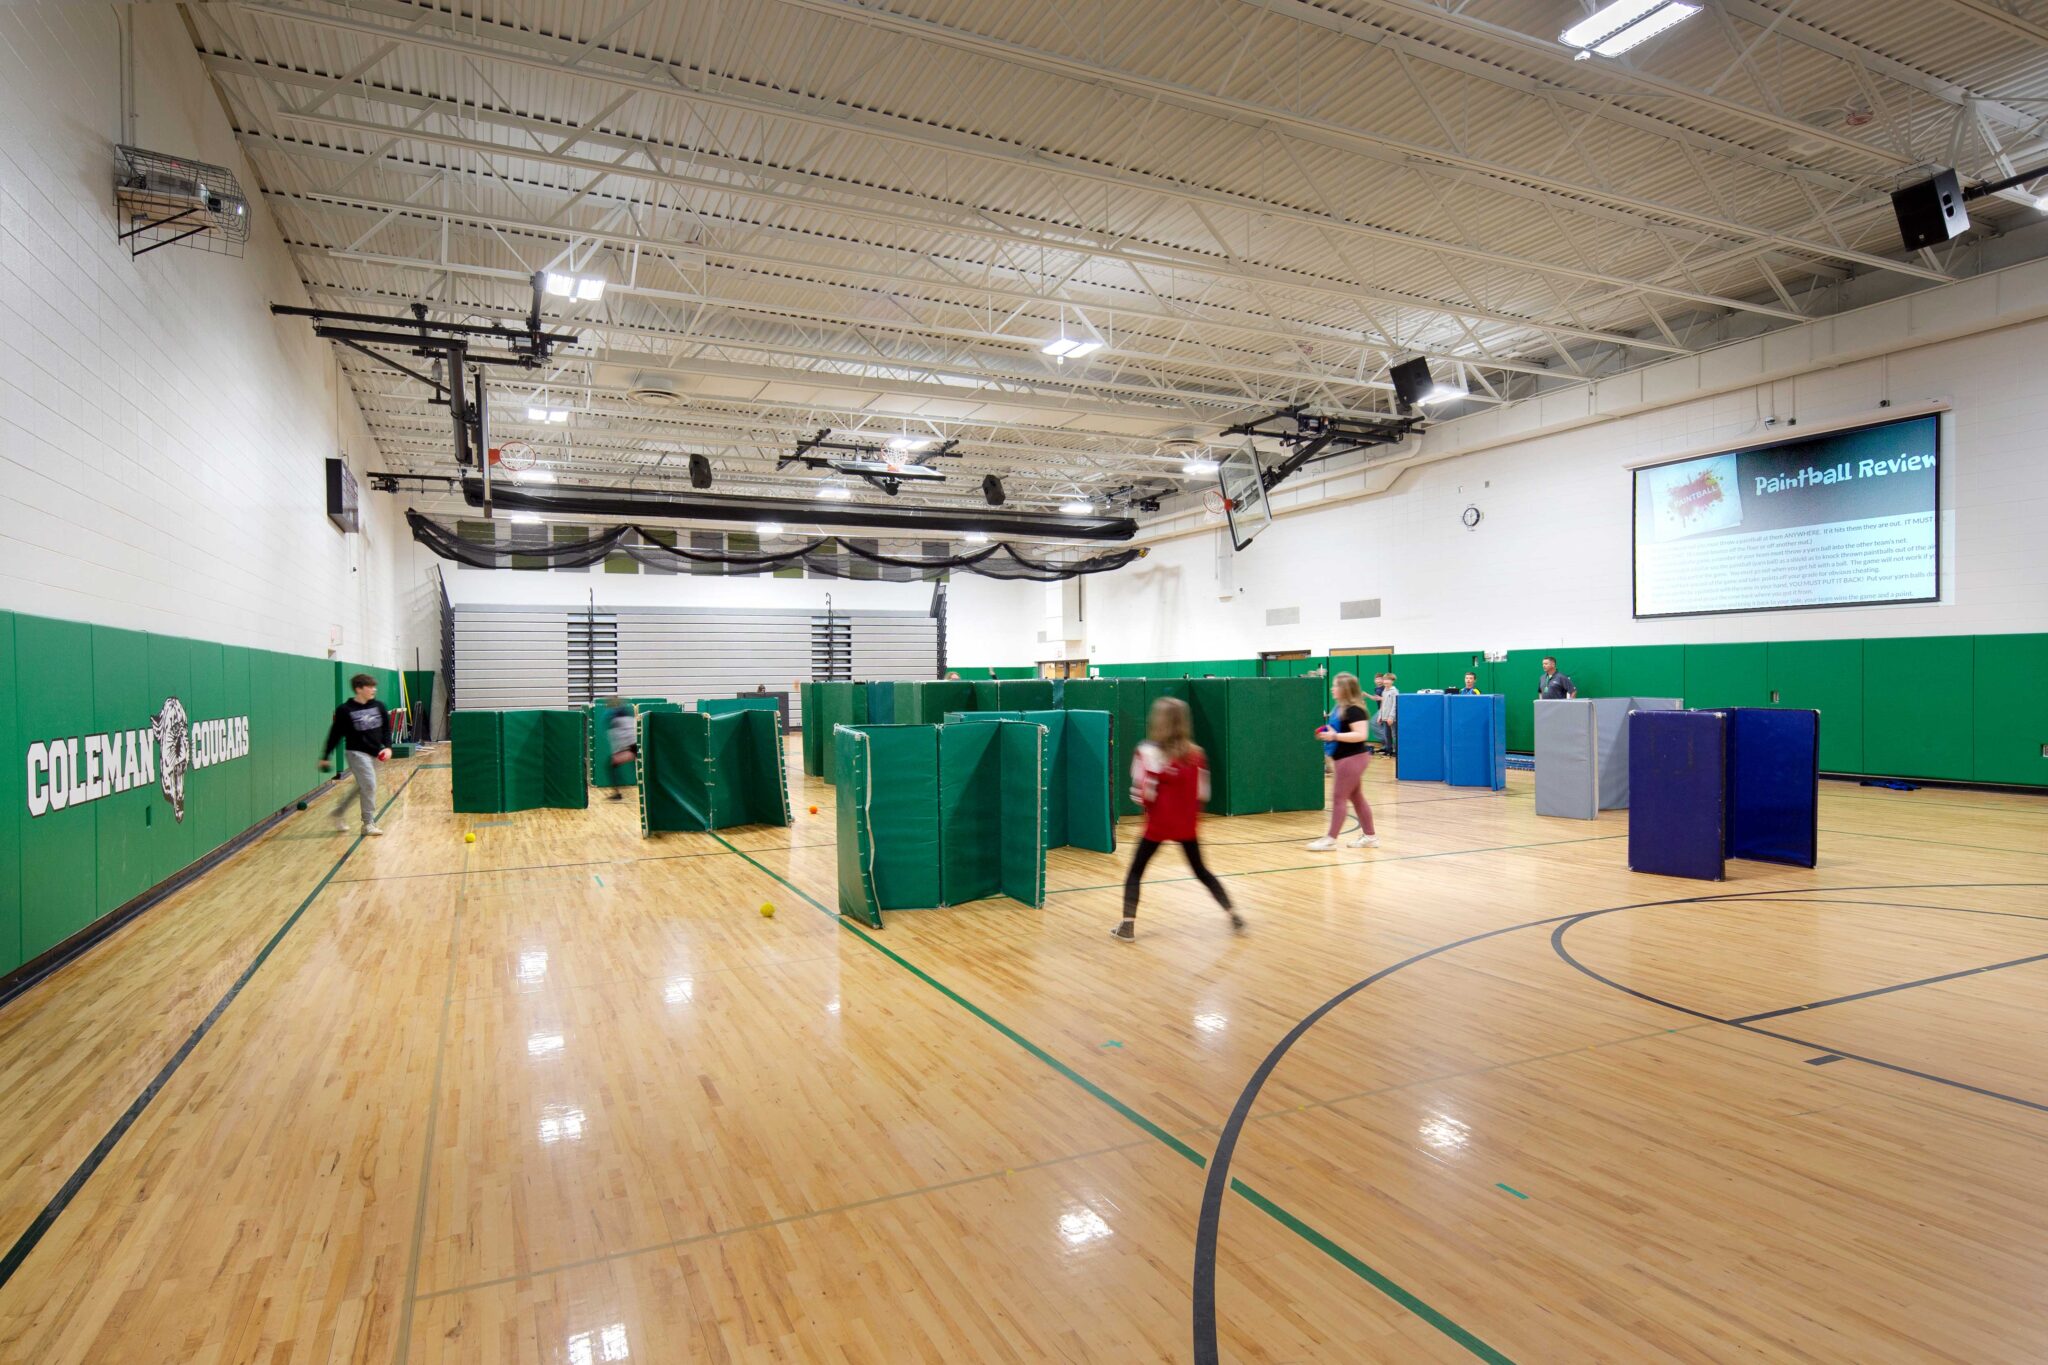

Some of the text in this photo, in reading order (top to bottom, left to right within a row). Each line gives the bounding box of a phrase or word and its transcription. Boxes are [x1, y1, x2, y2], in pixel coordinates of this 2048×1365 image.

[1755, 462, 1852, 496] Paintball
[1784, 530, 1821, 538] ANYWHERE.
[1864, 548, 1893, 556] paintballs
[27, 714, 249, 818] COLEMAN COUGARS
